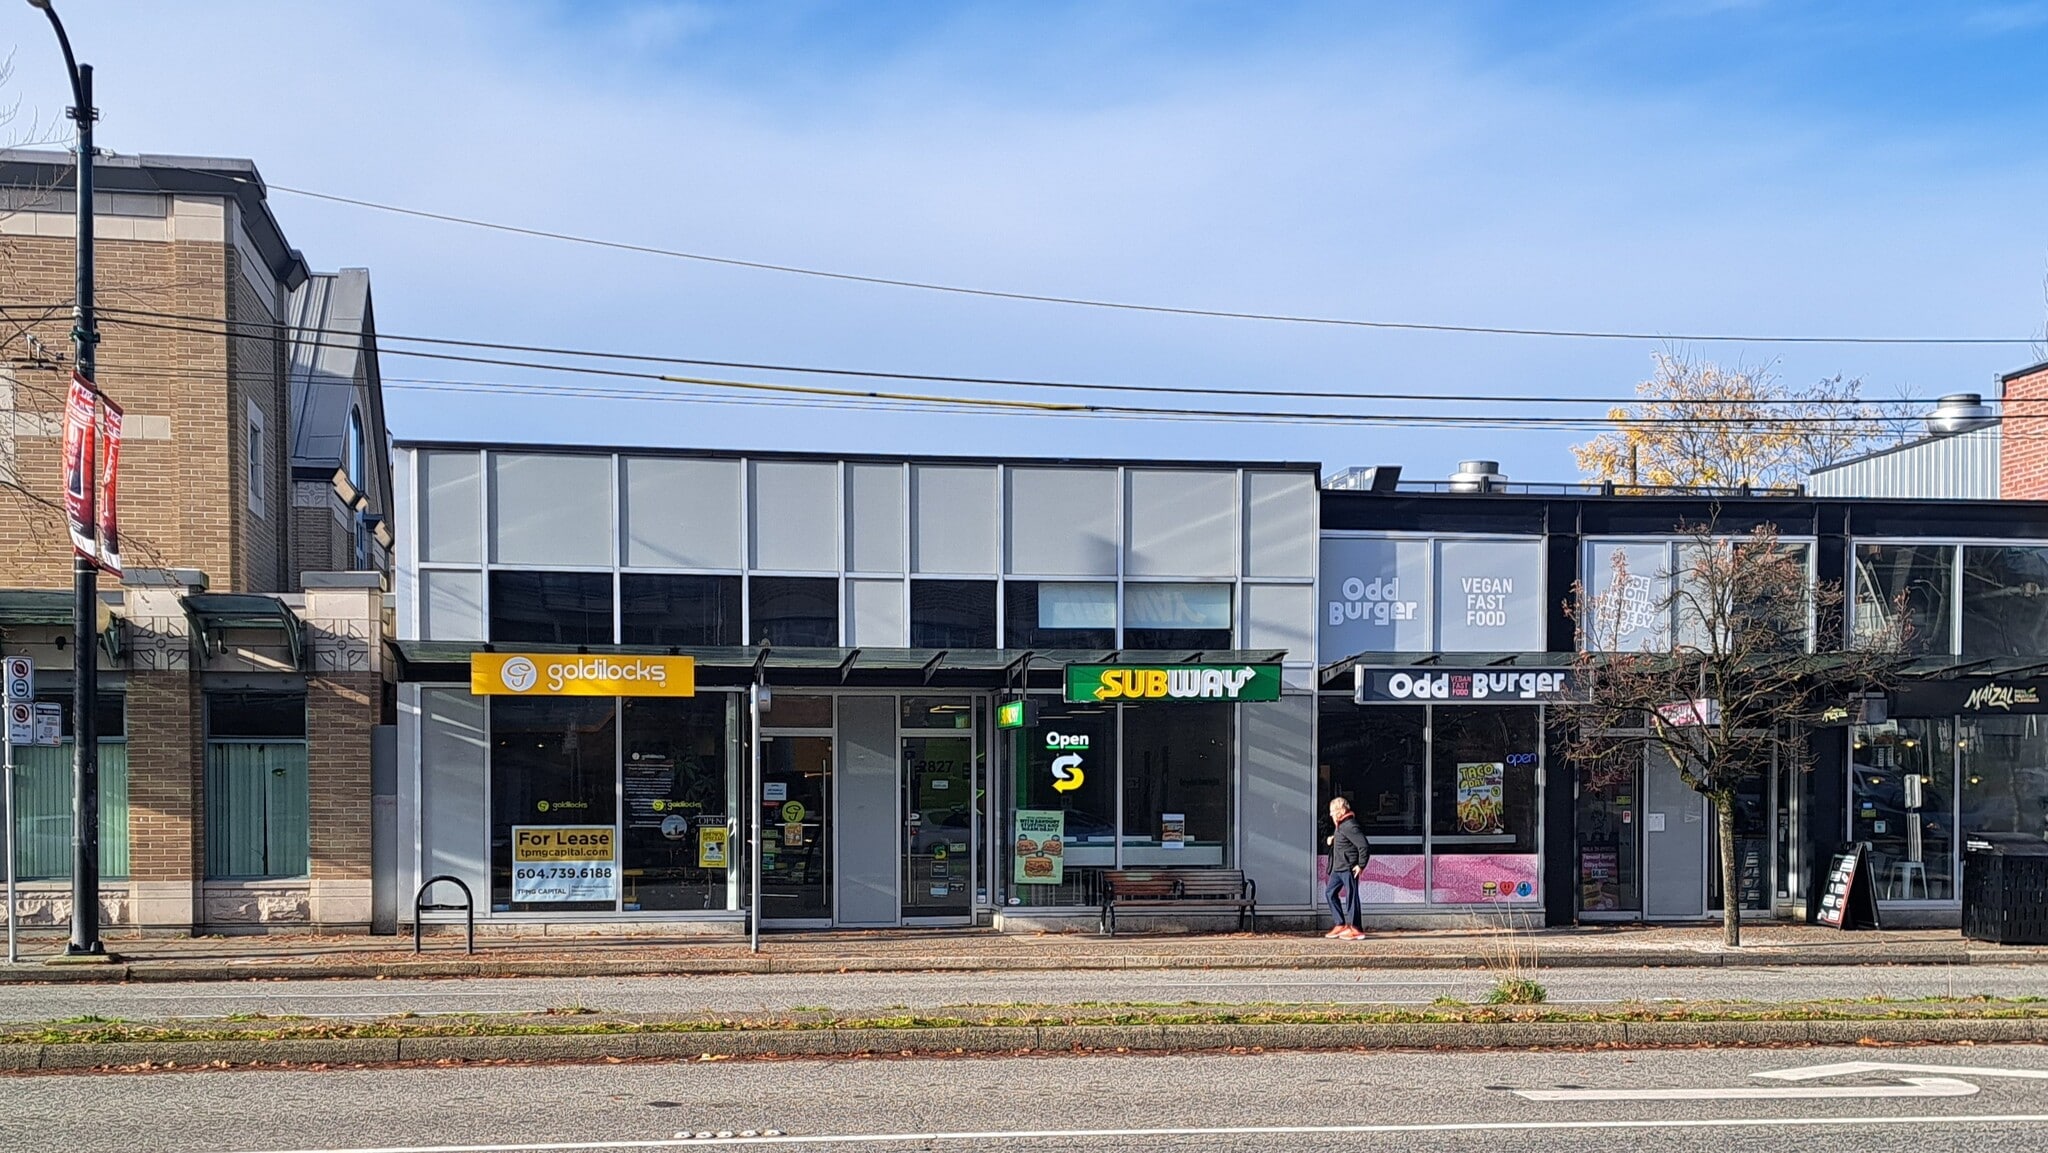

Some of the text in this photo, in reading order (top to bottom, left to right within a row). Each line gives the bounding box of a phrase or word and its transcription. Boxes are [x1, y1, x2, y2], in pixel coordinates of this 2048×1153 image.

[1342, 577, 1399, 601] Odd
[1461, 577, 1513, 594] VEGAN
[1466, 594, 1506, 610] FAST
[1328, 601, 1418, 626] Burger
[1466, 610, 1506, 627] FOOD
[1635, 613, 1653, 628] BY
[547, 658, 666, 691] goldilocks
[1450, 675, 1472, 684] VEGAN
[1093, 666, 1257, 701] SUBWAY
[1388, 672, 1565, 699] Odd Burger
[1451, 682, 1469, 690] FAST
[1451, 689, 1469, 697] FOOD
[1046, 731, 1090, 750] Open
[919, 760, 954, 773] 2827
[1506, 752, 1537, 767] open
[1459, 764, 1495, 781] TACO
[518, 831, 610, 846] For Lease
[520, 847, 609, 858] tpmgcapital.com
[516, 867, 612, 880] 604.739.6188
